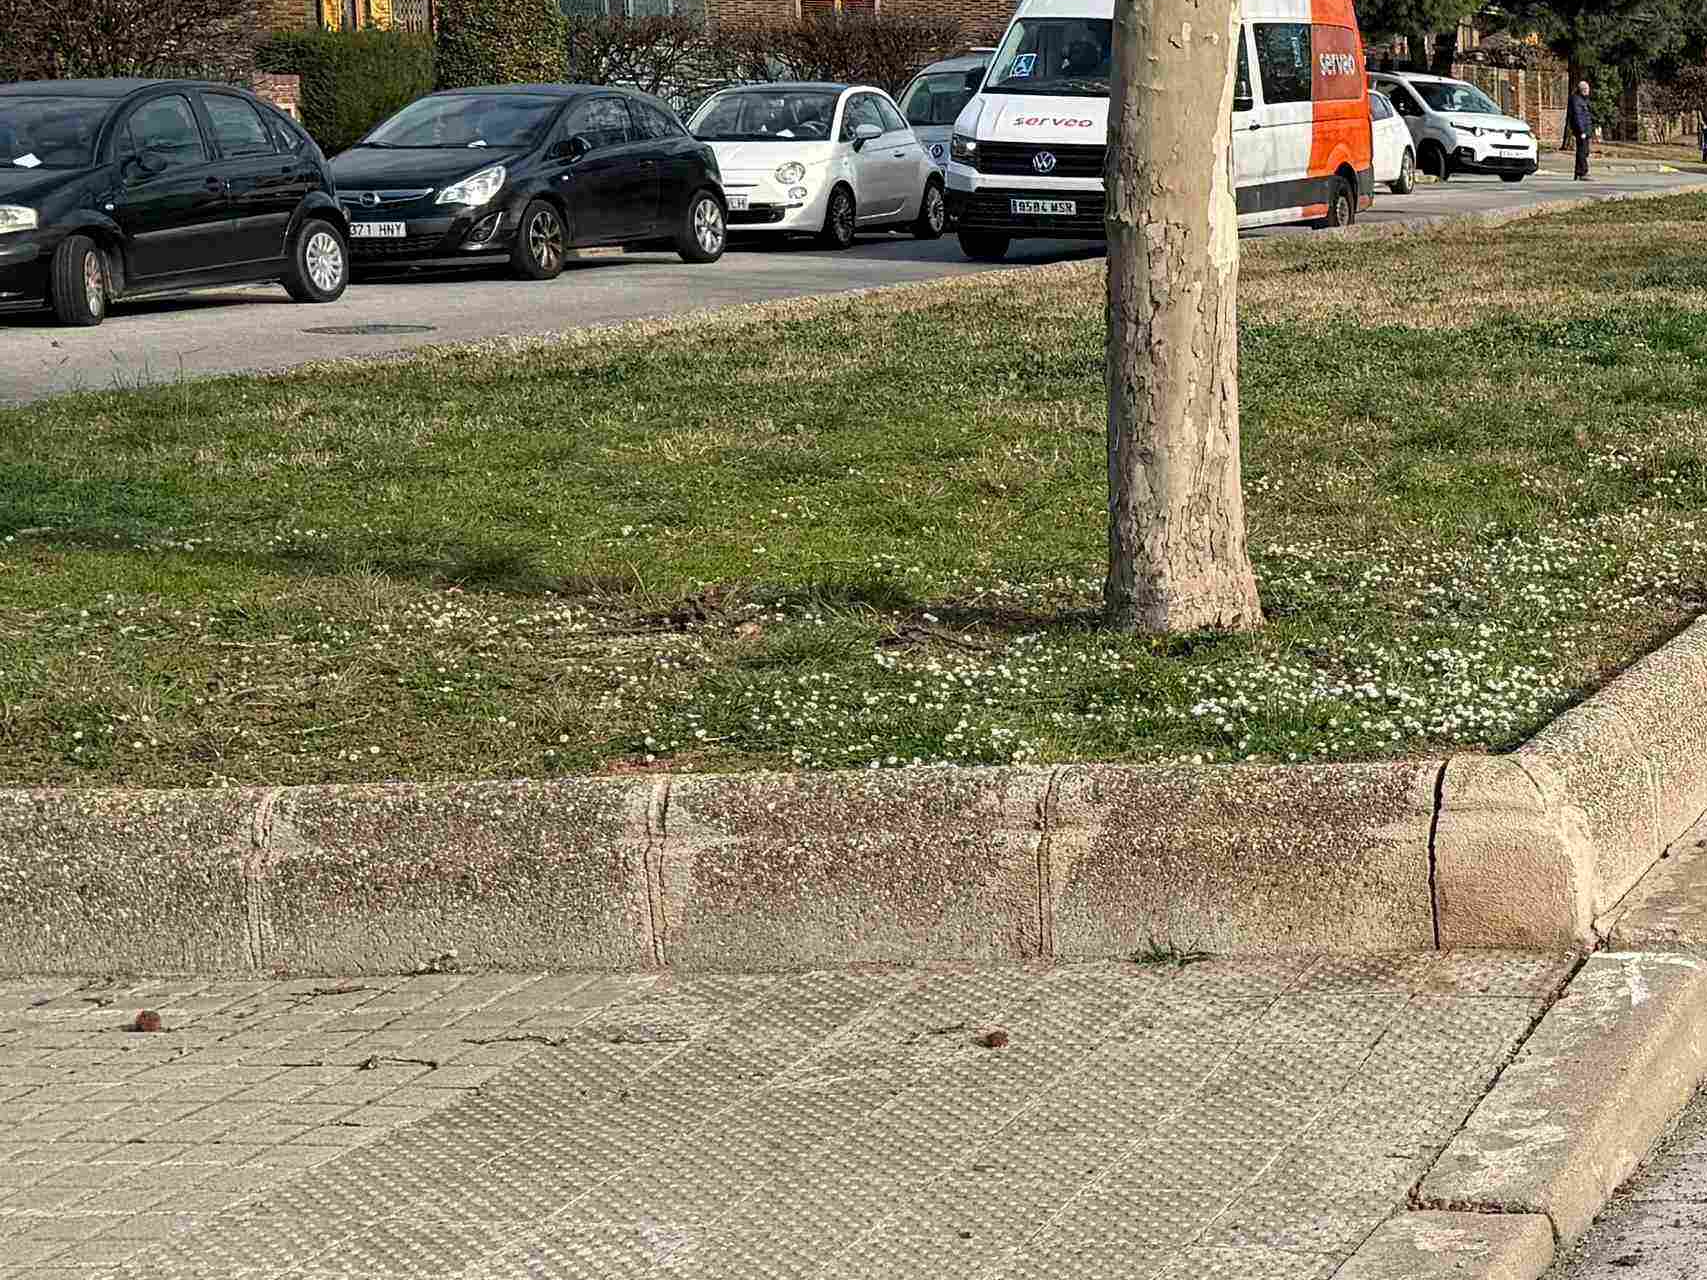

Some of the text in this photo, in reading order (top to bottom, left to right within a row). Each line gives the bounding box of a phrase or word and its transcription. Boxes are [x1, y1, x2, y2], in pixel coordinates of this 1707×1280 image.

[1319, 52, 1356, 75] serveo
[1013, 117, 1093, 127] serveo
[349, 223, 401, 235] 371 HNY
